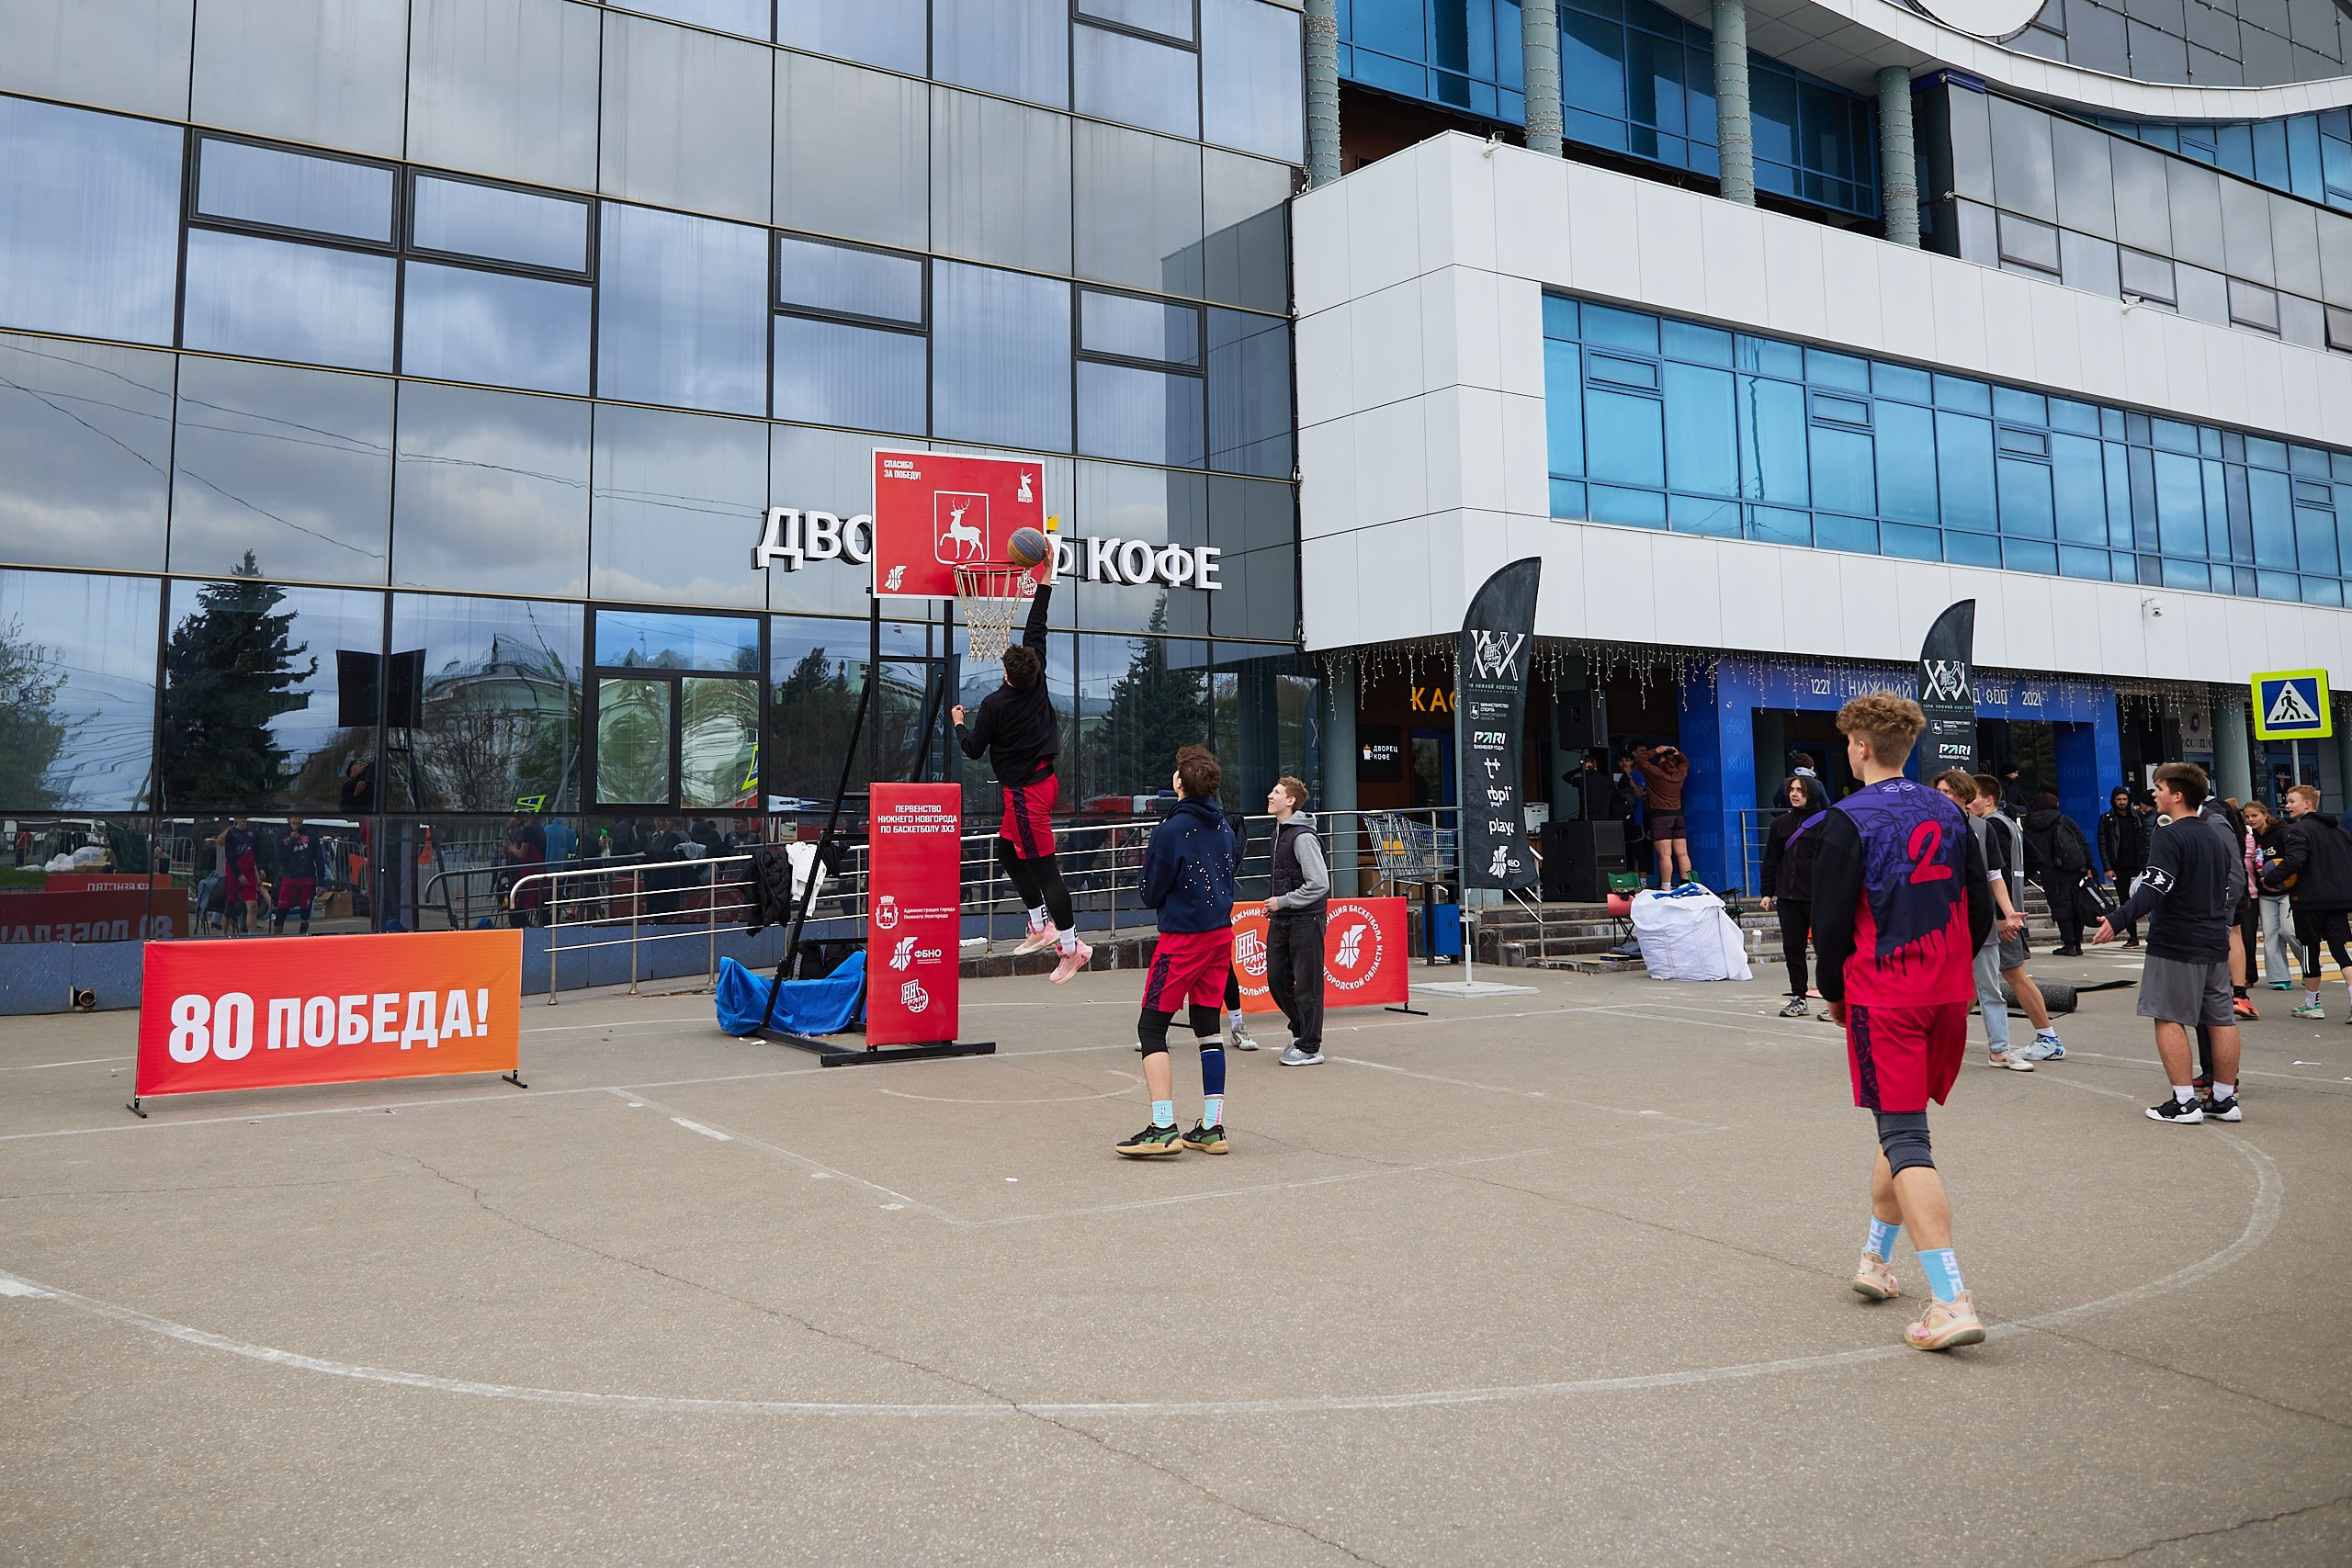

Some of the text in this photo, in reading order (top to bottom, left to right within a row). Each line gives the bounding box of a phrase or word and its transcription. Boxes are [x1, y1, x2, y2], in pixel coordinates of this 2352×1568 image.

[884, 459, 913, 468] СПАСИБО
[884, 469, 922, 480] ЗА ПОБЕДУ!
[756, 506, 872, 570] ДВО
[1087, 536, 1223, 590] КОФЕ
[1811, 679, 1831, 695] 1221
[2022, 691, 2041, 706] 2021
[1474, 731, 1506, 745] PARI
[1373, 745, 1397, 753] ДВОРЕЦ
[1939, 743, 1971, 755] PARI
[895, 805, 942, 813] ПЕРВЕНСТВО
[915, 815, 957, 824] НОВГОРОДА
[893, 825, 939, 833] БАСКЕТБОЛУ
[1907, 819, 1953, 886] 2
[1231, 908, 1261, 926] ИЖНИЙ
[1349, 904, 1383, 942] БАСКЕТБОЛА
[914, 949, 942, 958] ФБНО
[1364, 944, 1384, 982] ОБЛАСТИ
[168, 987, 490, 1064] 80 ПОБЕДА!
